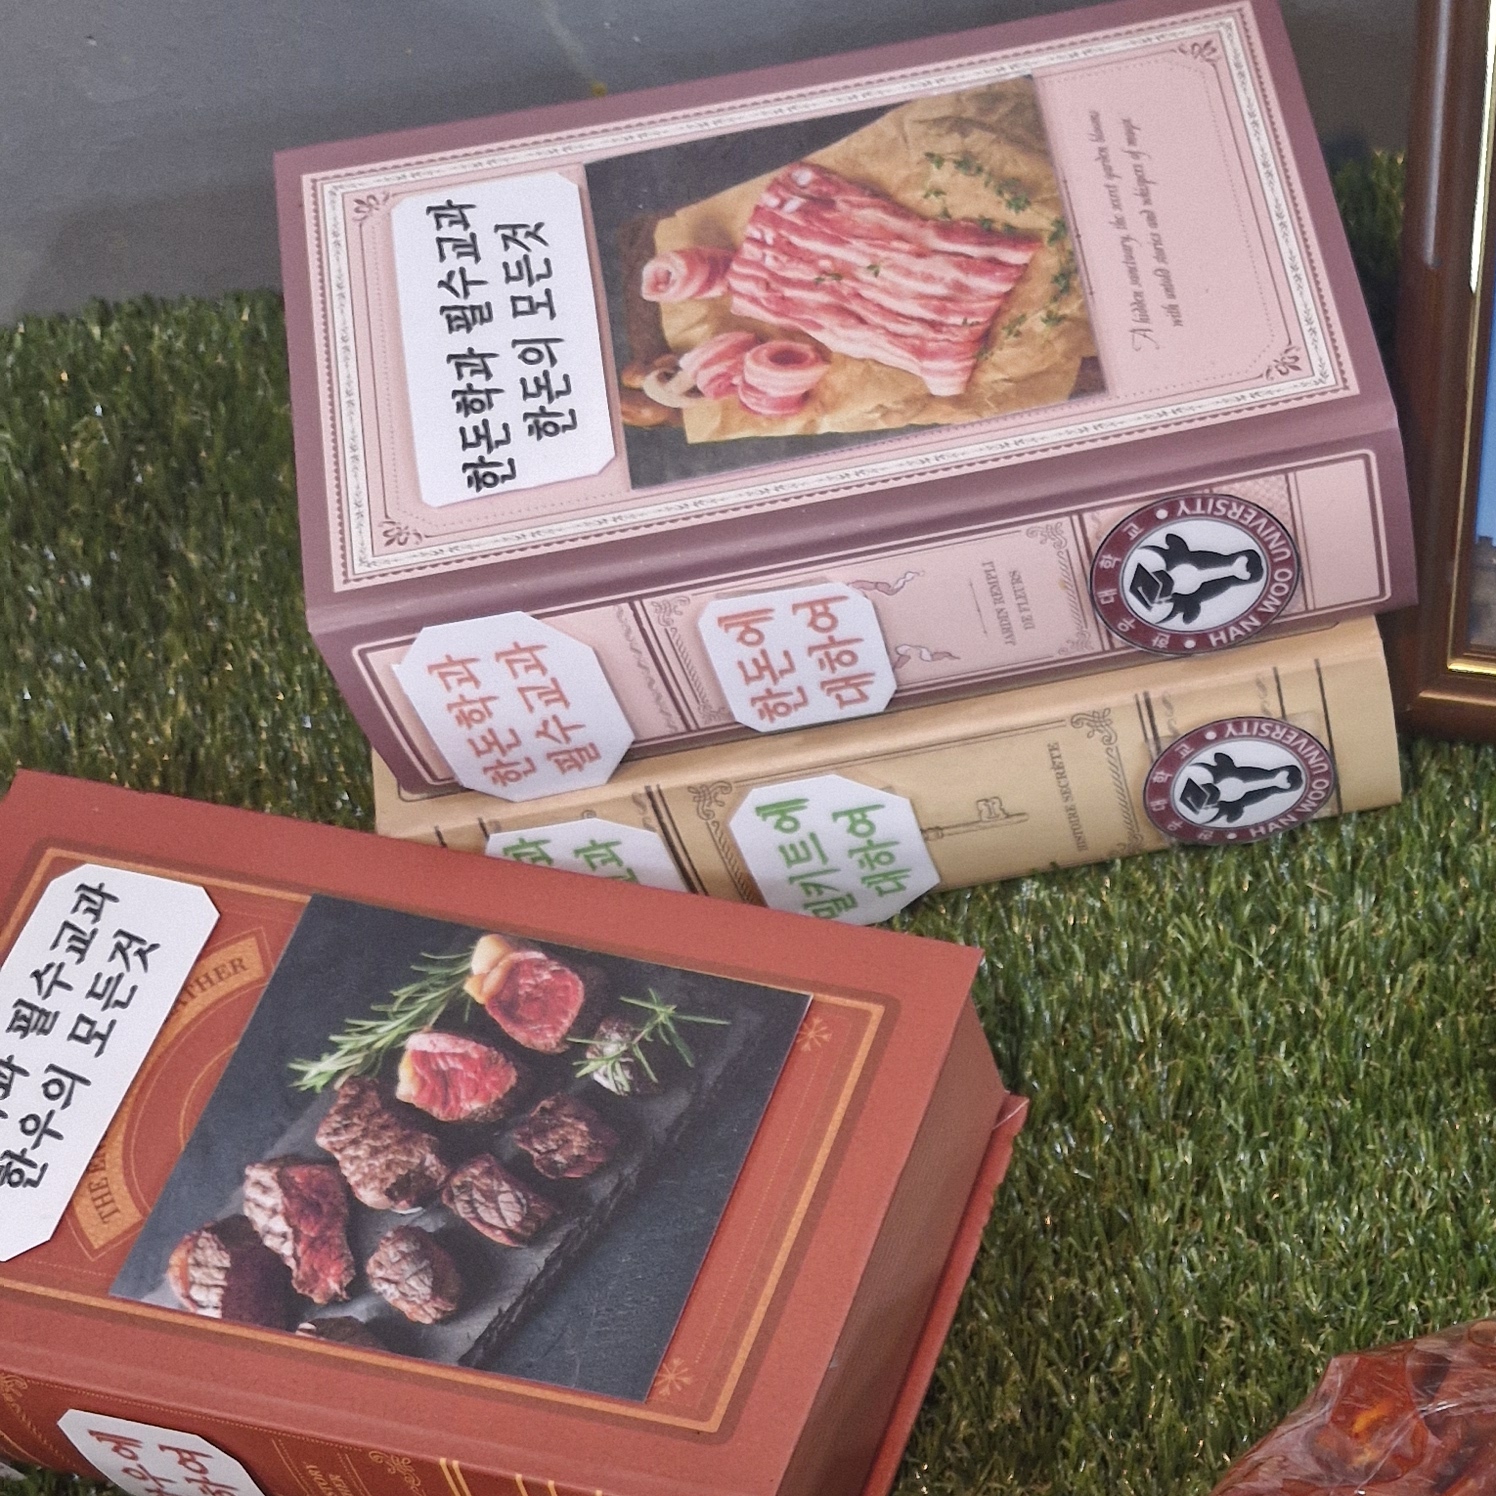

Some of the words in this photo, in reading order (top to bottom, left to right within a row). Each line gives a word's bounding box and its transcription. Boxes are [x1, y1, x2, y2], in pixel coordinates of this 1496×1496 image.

[425, 199, 494, 334] 필수교과
[494, 221, 557, 321] 모든것
[446, 347, 517, 493] 한돈학과
[511, 337, 578, 441] 한돈의
[1177, 498, 1291, 562] UNIVERSITY
[982, 561, 1005, 605] REMPLI
[995, 608, 1016, 646] JARDIN
[1009, 570, 1030, 613] FLEURS
[1093, 522, 1171, 649] 한우대학교
[1208, 615, 1262, 647] HAN
[1257, 568, 1293, 615] WOO
[717, 608, 809, 723] 한돈에
[791, 595, 876, 710] 대하여
[427, 654, 537, 787] 한돈학과
[494, 641, 602, 775] 필수교과
[1224, 722, 1329, 775] UNIVERSITY
[1250, 814, 1298, 838] HAN
[1296, 780, 1329, 813] WOO
[755, 798, 859, 919] 밀키트에
[832, 803, 912, 897] 대하여
[6, 881, 120, 1040] 필수교과
[0, 1063, 92, 1189] 한우의
[67, 928, 161, 1058] 모든것
[88, 1178, 121, 1224] THE
